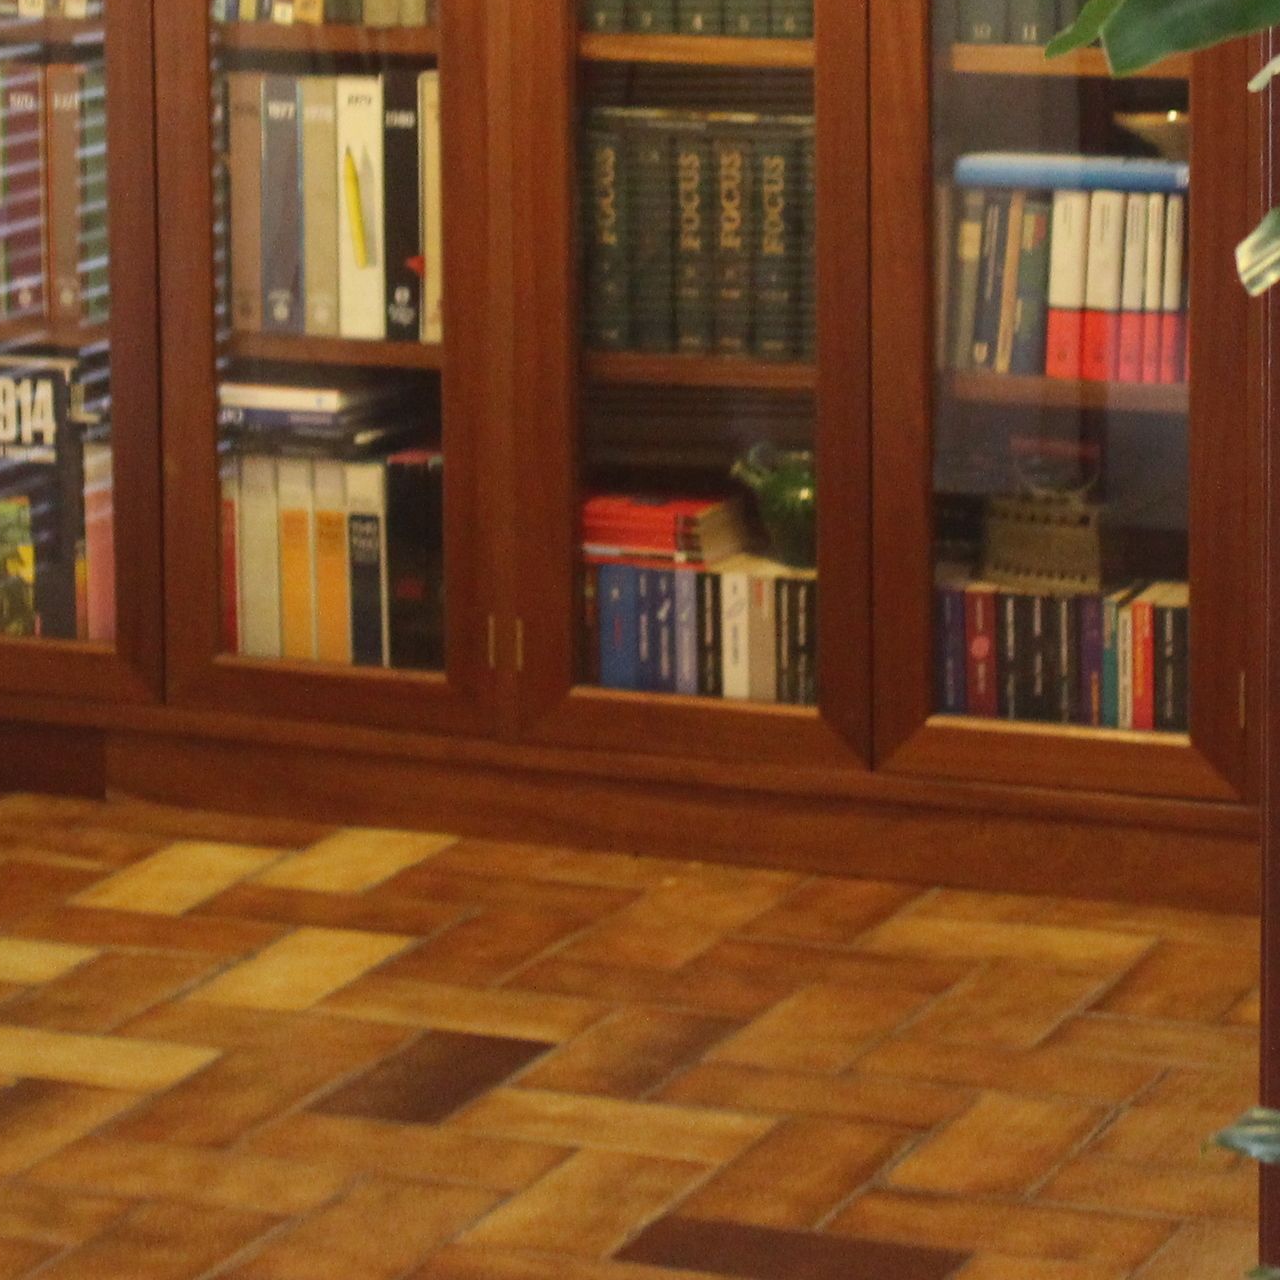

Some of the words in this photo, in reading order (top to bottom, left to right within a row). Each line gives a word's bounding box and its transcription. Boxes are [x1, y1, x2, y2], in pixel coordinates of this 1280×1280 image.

[677, 151, 701, 252] FOCUS
[719, 150, 743, 250] FOCUS
[762, 154, 786, 256] FOCUS
